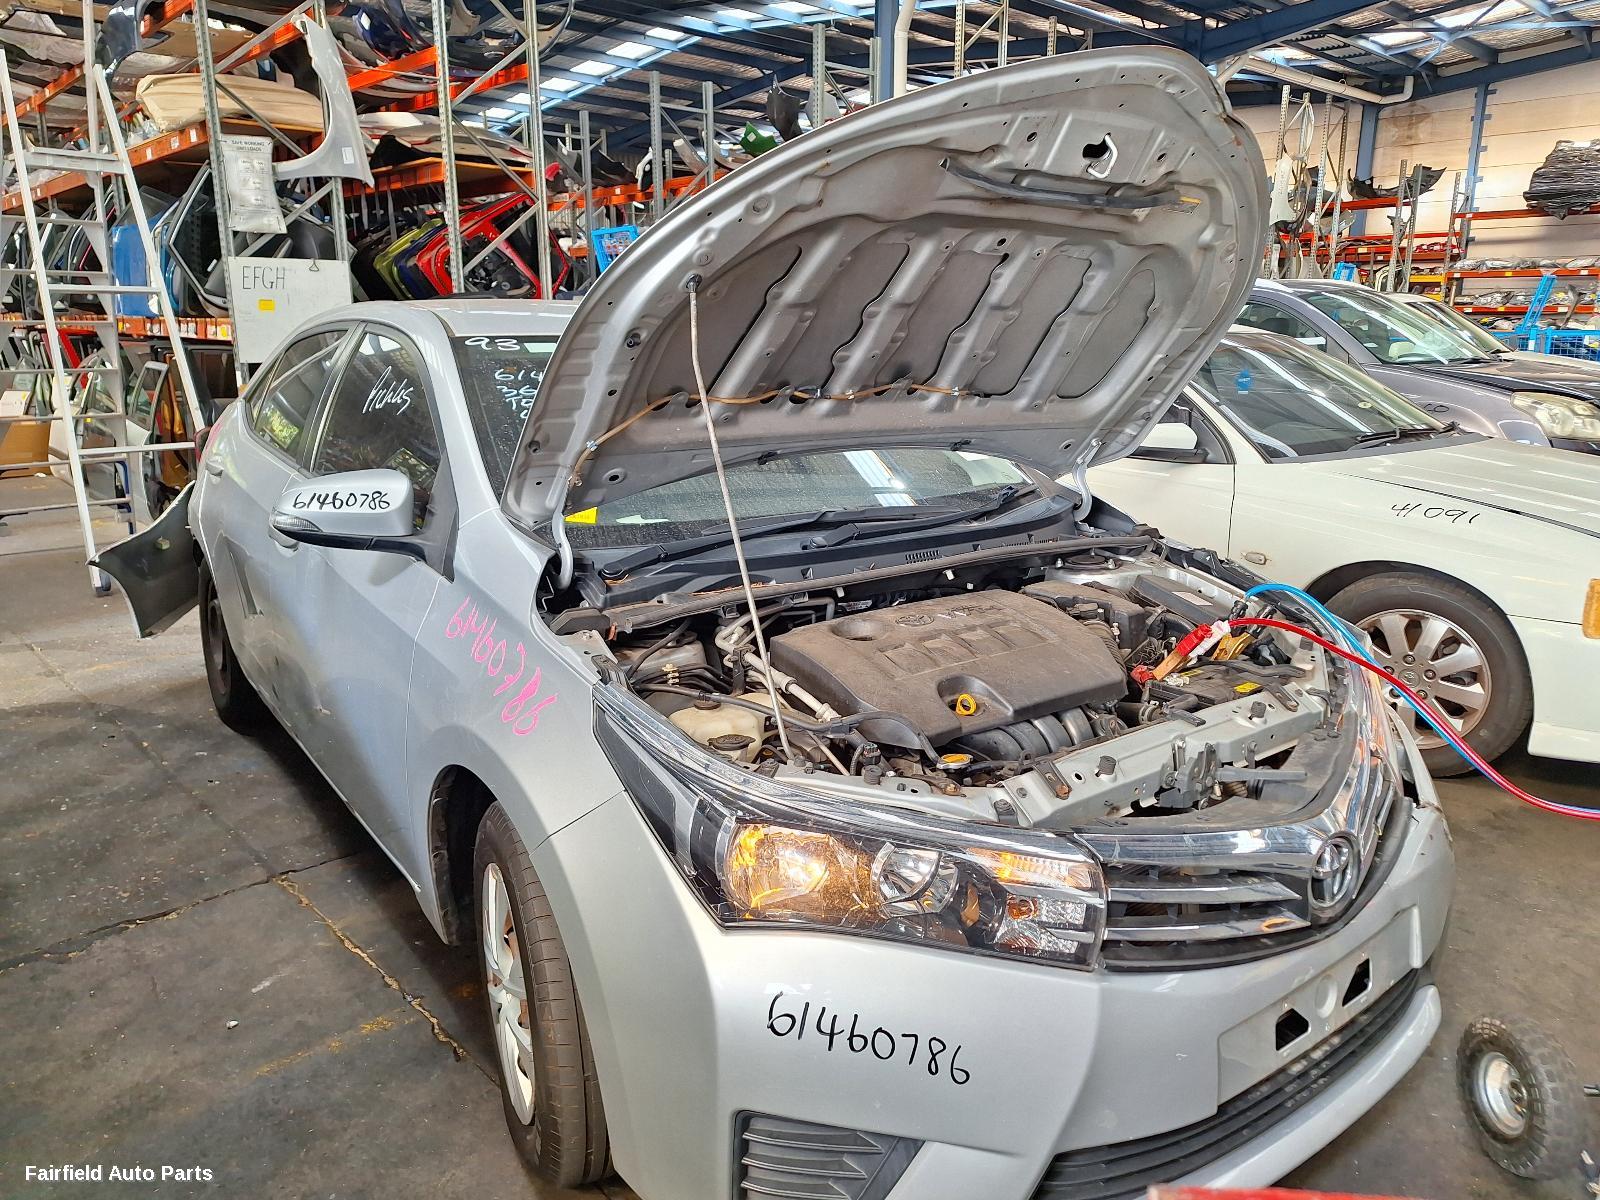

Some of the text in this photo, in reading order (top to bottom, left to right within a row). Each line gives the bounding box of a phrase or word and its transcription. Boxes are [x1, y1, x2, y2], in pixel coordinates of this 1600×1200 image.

[242, 265, 286, 290] EFGH
[464, 336, 521, 351] 93
[292, 490, 391, 511] 61460786
[767, 991, 970, 1085] 61460786
